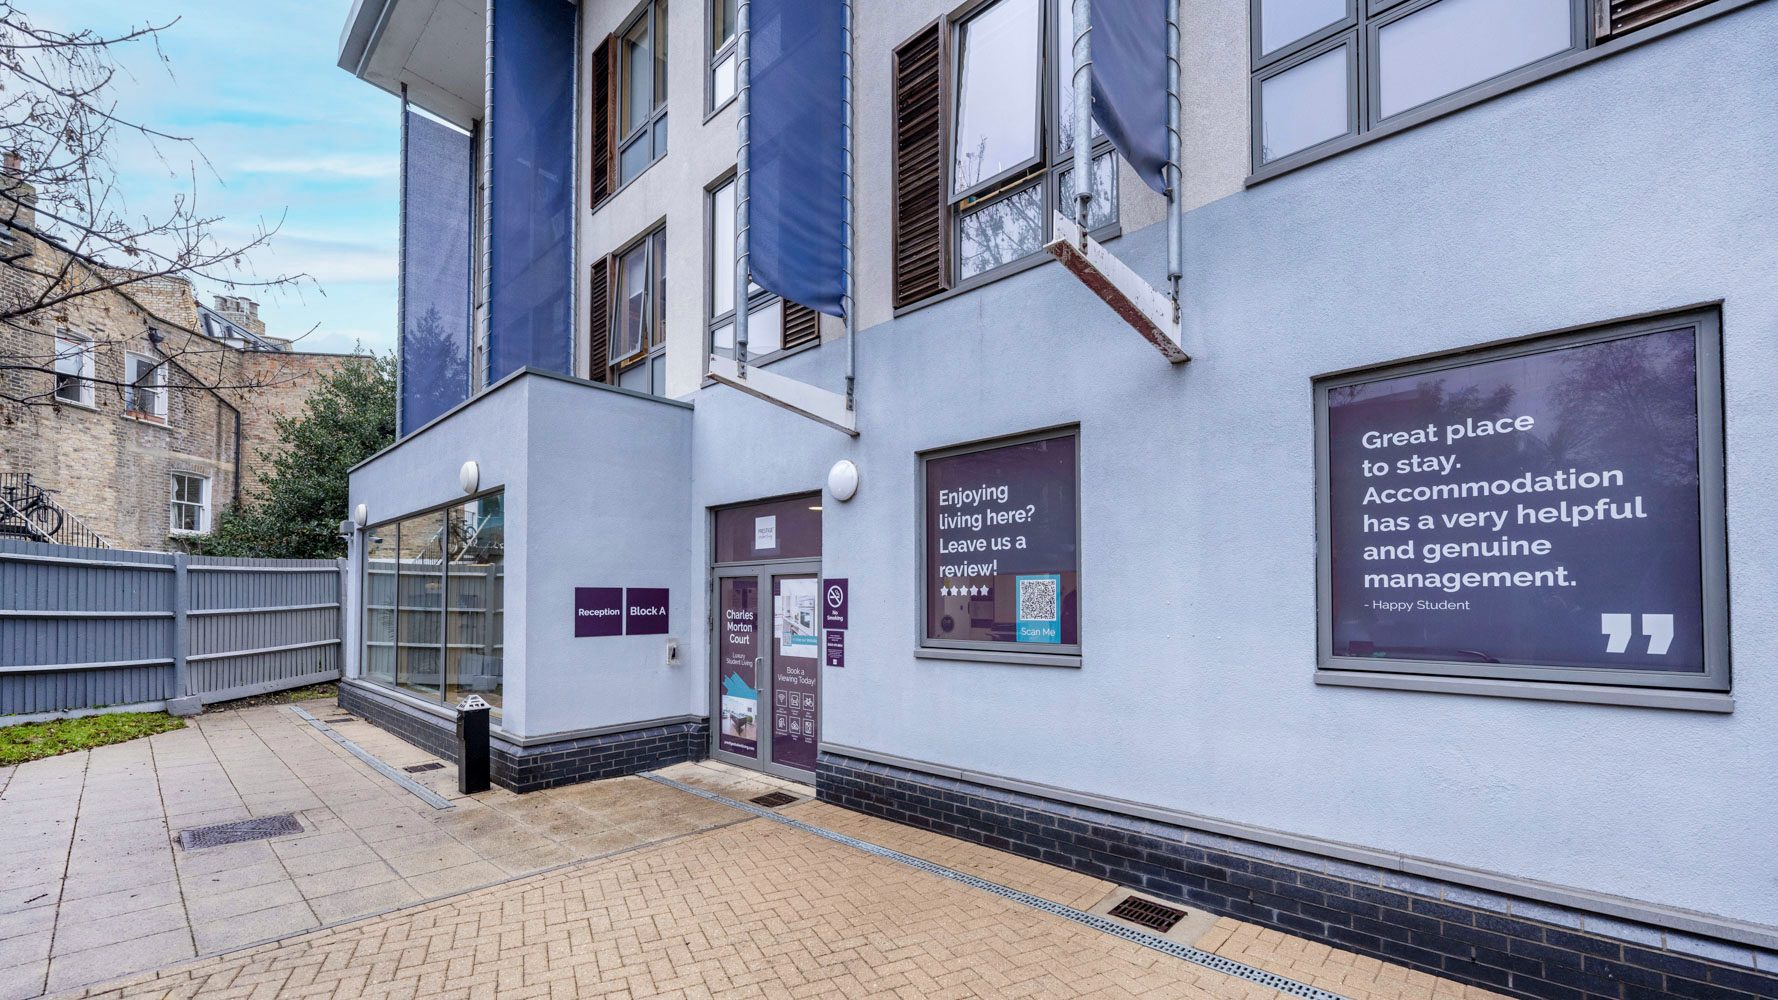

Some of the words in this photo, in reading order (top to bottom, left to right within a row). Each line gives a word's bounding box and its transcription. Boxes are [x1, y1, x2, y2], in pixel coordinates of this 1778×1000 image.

[1362, 423, 1437, 449] Great
[1446, 415, 1535, 445] place
[1362, 458, 1389, 477] to
[1396, 453, 1461, 476] stay.
[1362, 467, 1624, 505] Accommodation
[939, 484, 1008, 507] Enjoying
[939, 513, 982, 531] living
[986, 504, 1035, 526] here?
[1363, 514, 1411, 532] has
[1418, 513, 1434, 530] a
[1442, 508, 1508, 531] very
[1517, 496, 1647, 527] helpful
[939, 537, 987, 554] Leave
[991, 534, 1011, 550] us
[1015, 535, 1027, 549] a
[1363, 540, 1414, 560] and
[1423, 536, 1552, 564] genuine
[939, 559, 998, 577] review!
[1364, 566, 1577, 592] management.
[578, 607, 620, 617] Reception
[630, 606, 657, 616] Block
[659, 606, 666, 616] A
[1372, 600, 1414, 612] Happy
[1416, 599, 1470, 611] Student
[726, 609, 753, 620] Charles
[727, 621, 753, 633] Morton
[1021, 626, 1041, 636] Scan
[1042, 626, 1056, 637] Me
[729, 634, 750, 645] Court
[732, 652, 746, 660] Luxury
[726, 658, 740, 666] Student
[741, 660, 753, 668] Living
[786, 666, 800, 675] Book
[777, 674, 798, 685] Viewing
[798, 675, 816, 687] Today!
